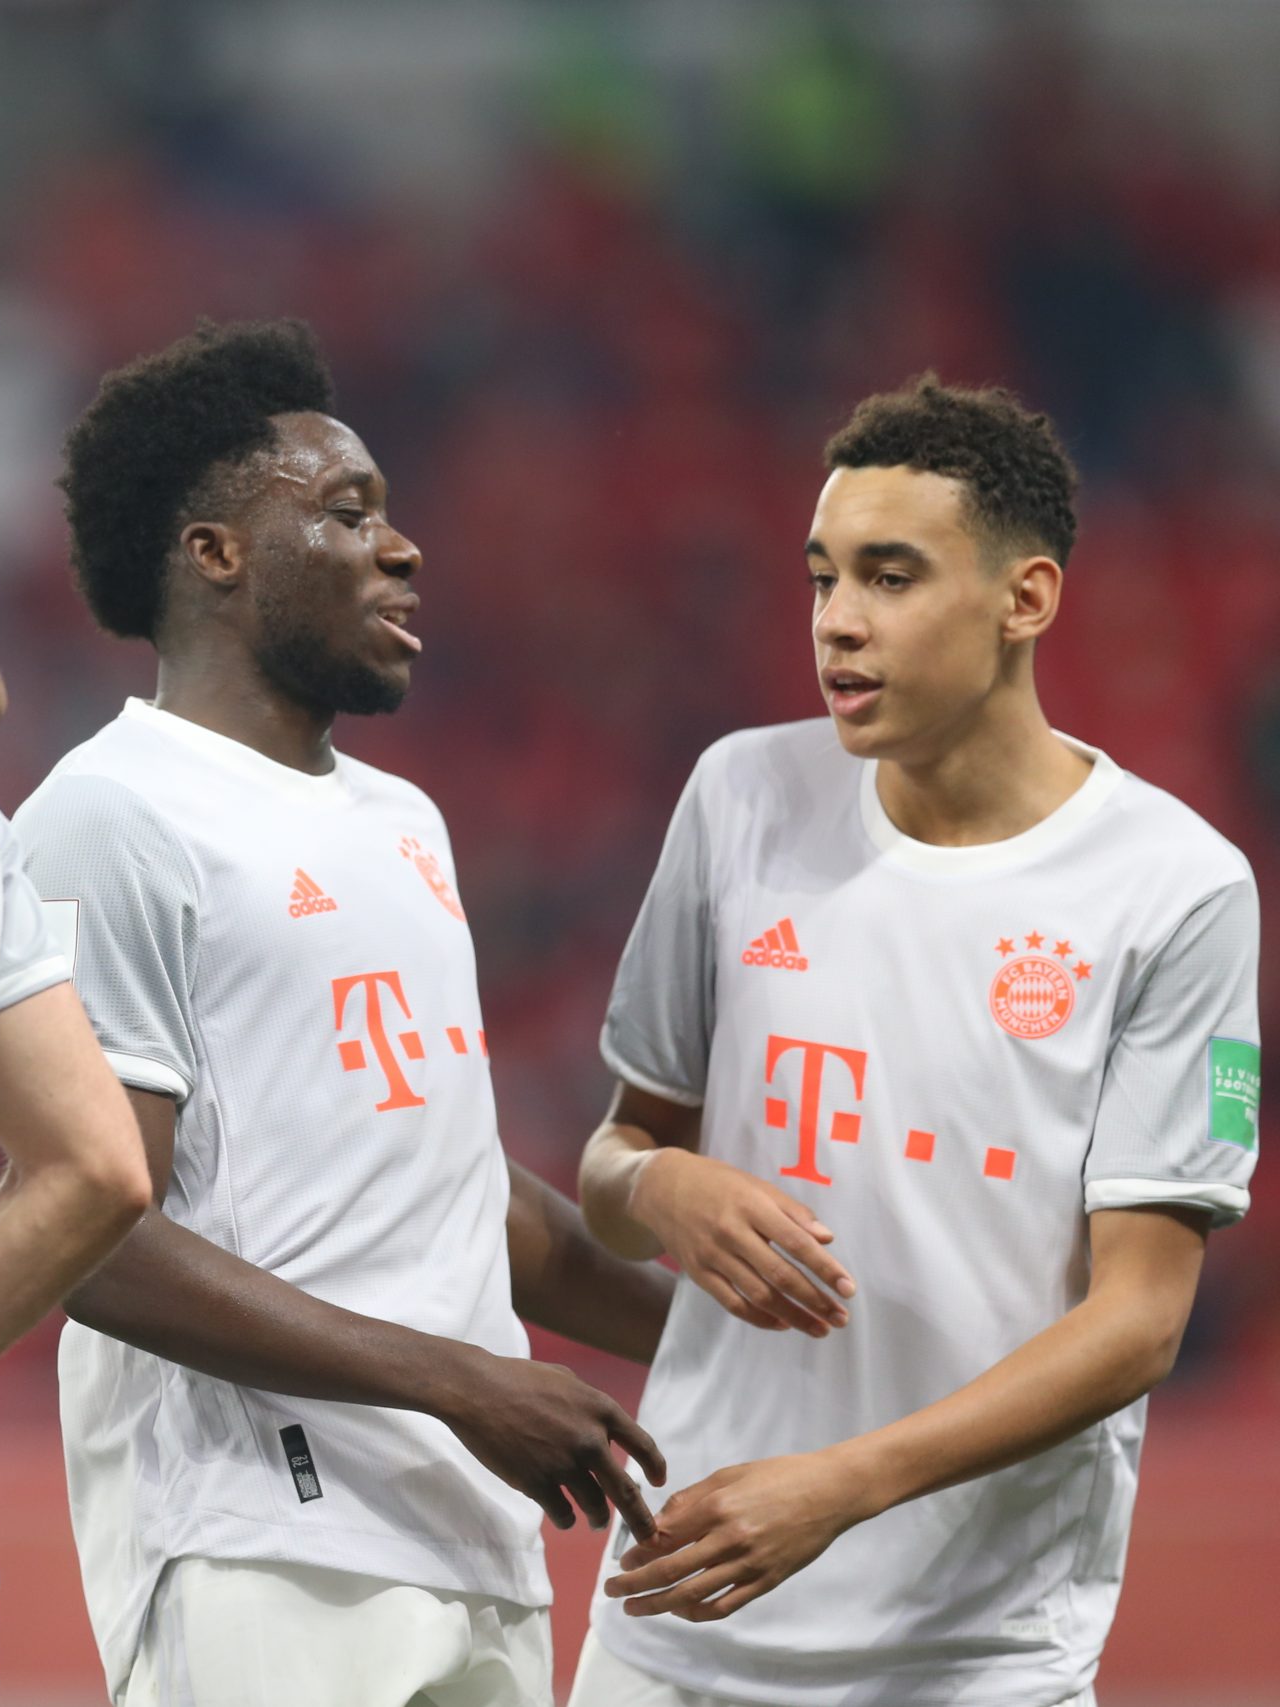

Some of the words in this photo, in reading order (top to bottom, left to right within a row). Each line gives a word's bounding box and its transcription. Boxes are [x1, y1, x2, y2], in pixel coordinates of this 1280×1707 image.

[288, 897, 338, 919] adidas
[741, 949, 810, 972] adidas
[1001, 967, 1020, 985] FC
[1023, 962, 1069, 1000] BAYERN
